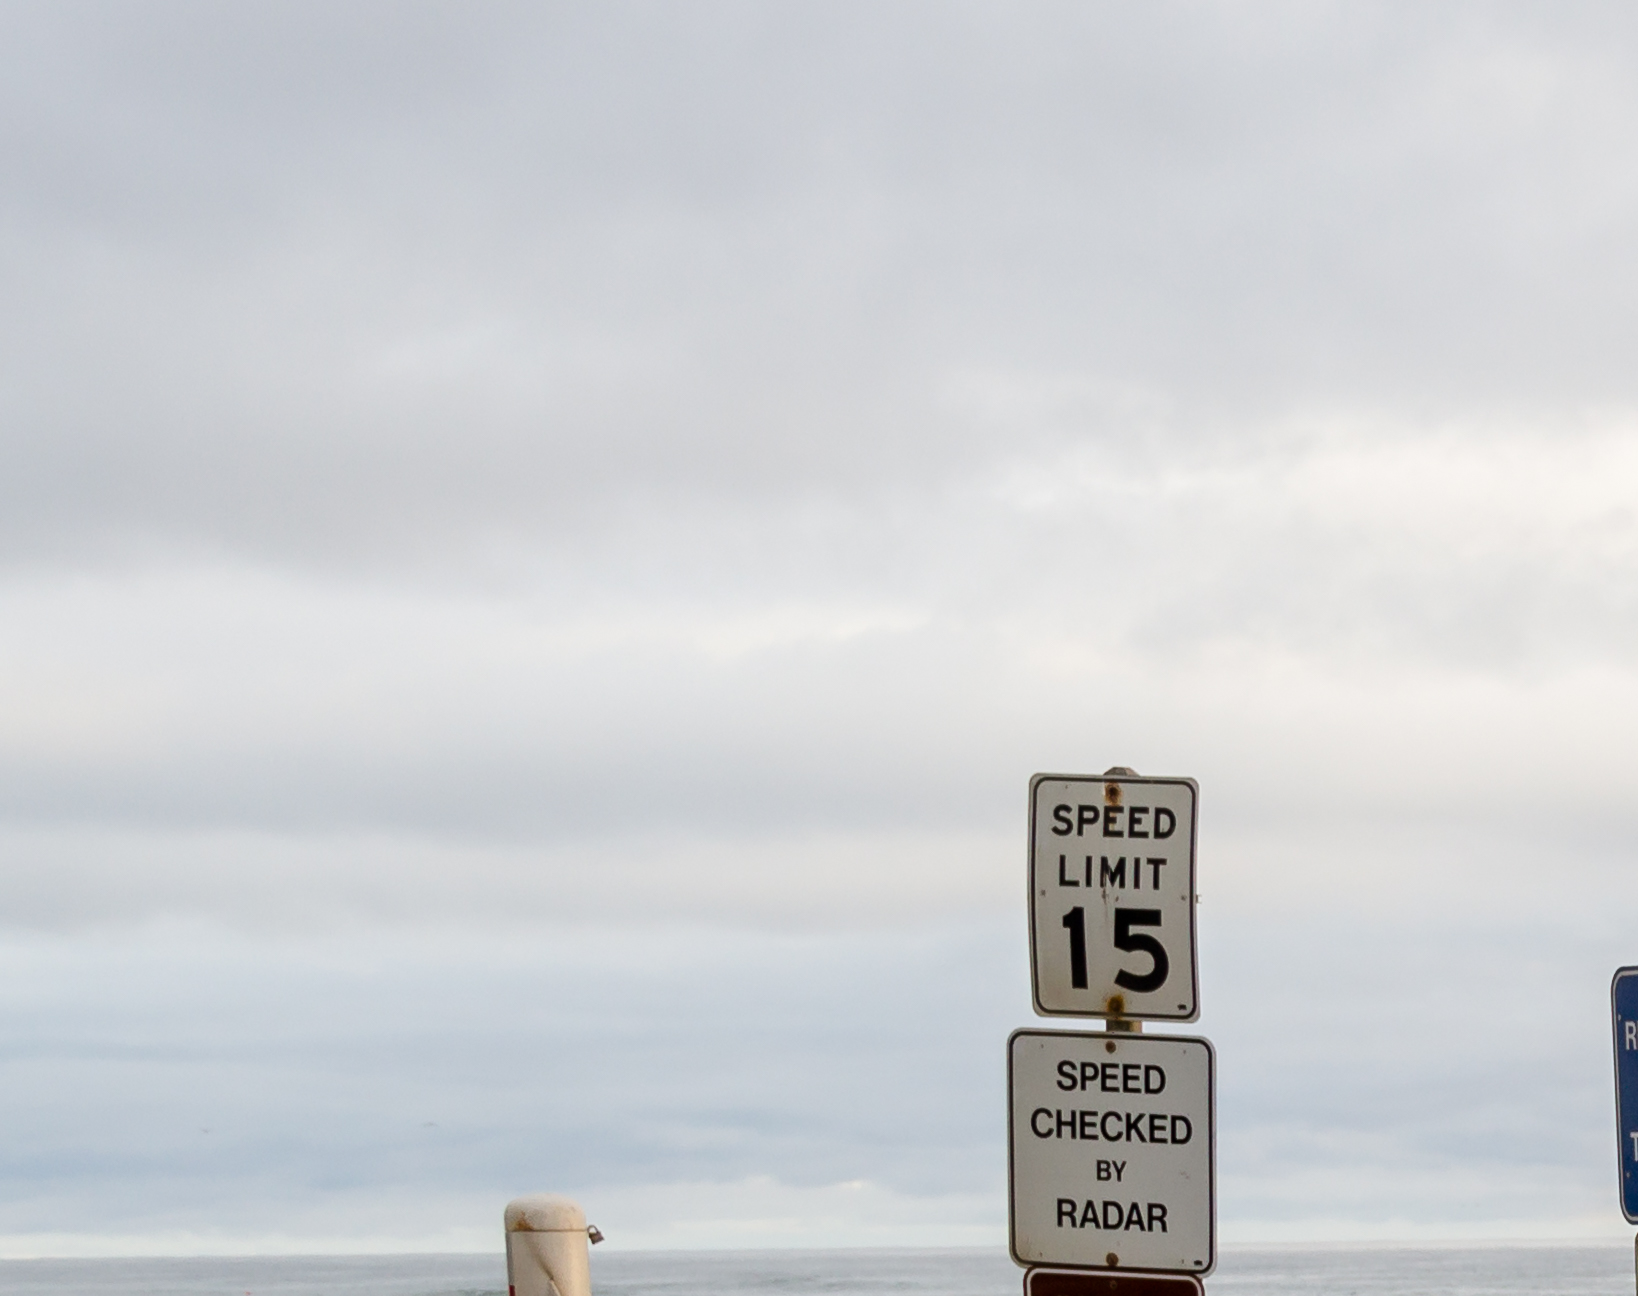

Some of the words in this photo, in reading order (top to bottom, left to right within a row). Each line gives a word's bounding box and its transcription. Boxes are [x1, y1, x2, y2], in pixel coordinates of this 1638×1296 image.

[1051, 804, 1176, 839] SPEED
[1059, 855, 1167, 890] LIMIT
[1062, 906, 1169, 993] 15
[1056, 1060, 1166, 1094] SPEED
[1031, 1108, 1192, 1145] CHECKED
[1096, 1160, 1126, 1182] BY
[1056, 1198, 1168, 1233] RADAR
